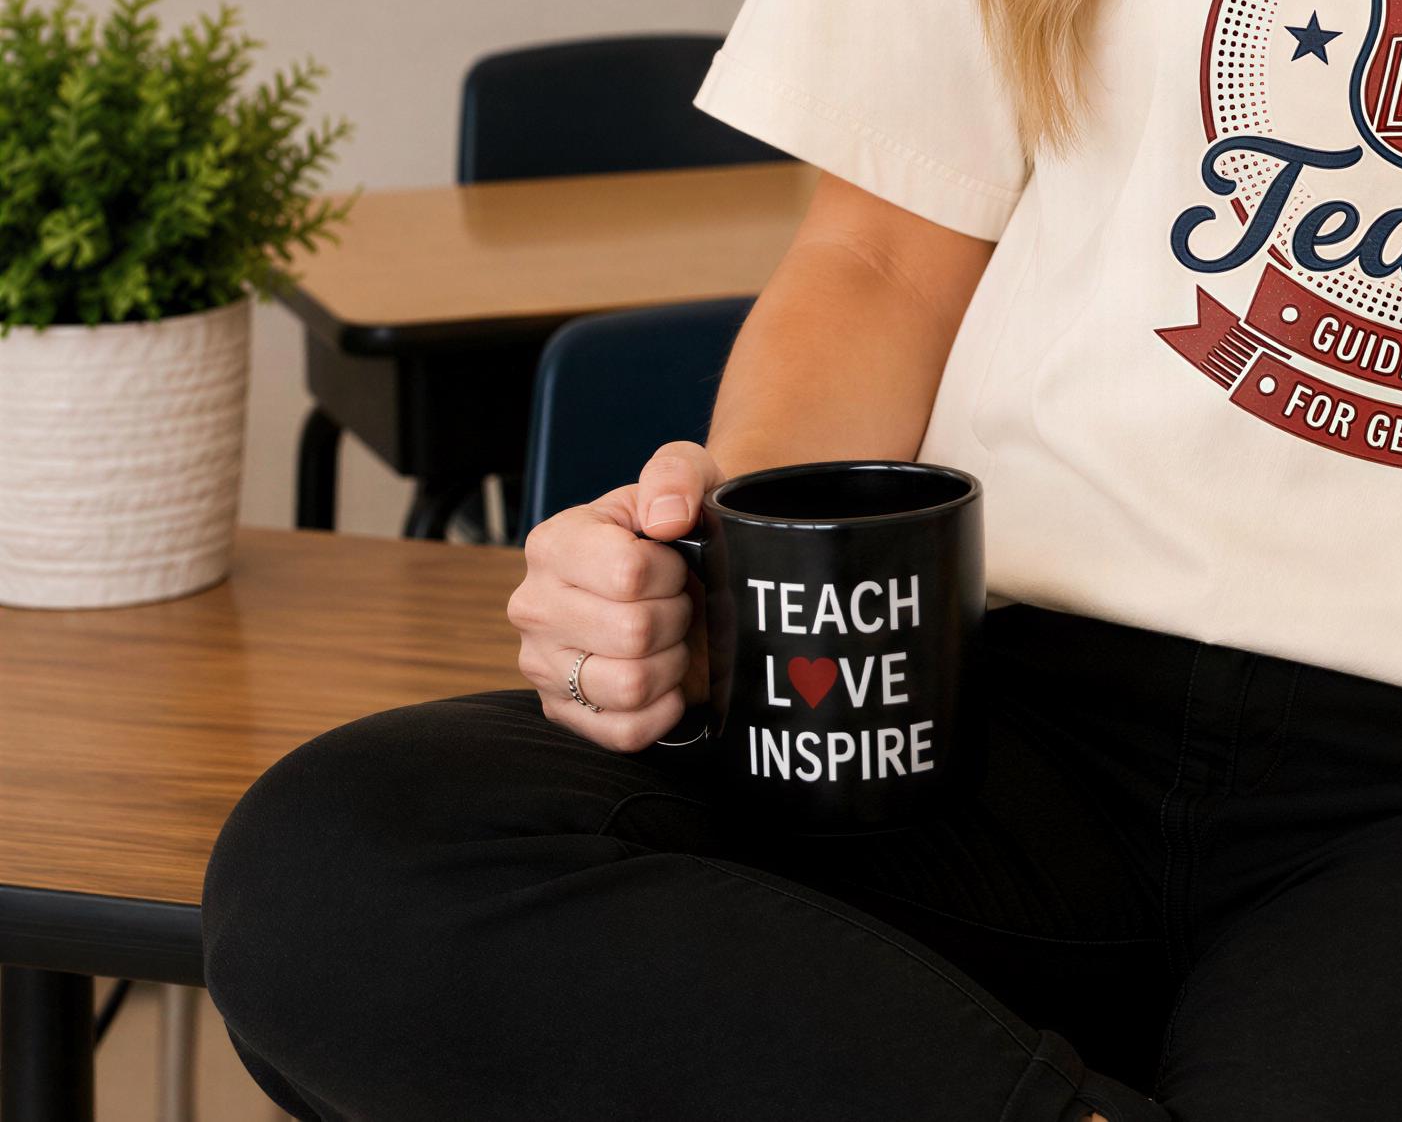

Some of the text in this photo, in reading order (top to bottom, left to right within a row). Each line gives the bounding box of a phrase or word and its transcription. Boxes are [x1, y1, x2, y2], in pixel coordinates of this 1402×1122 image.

[1283, 385, 1355, 440] FOR
[747, 575, 920, 635] TEACH
[748, 720, 935, 782] INSPIRE
